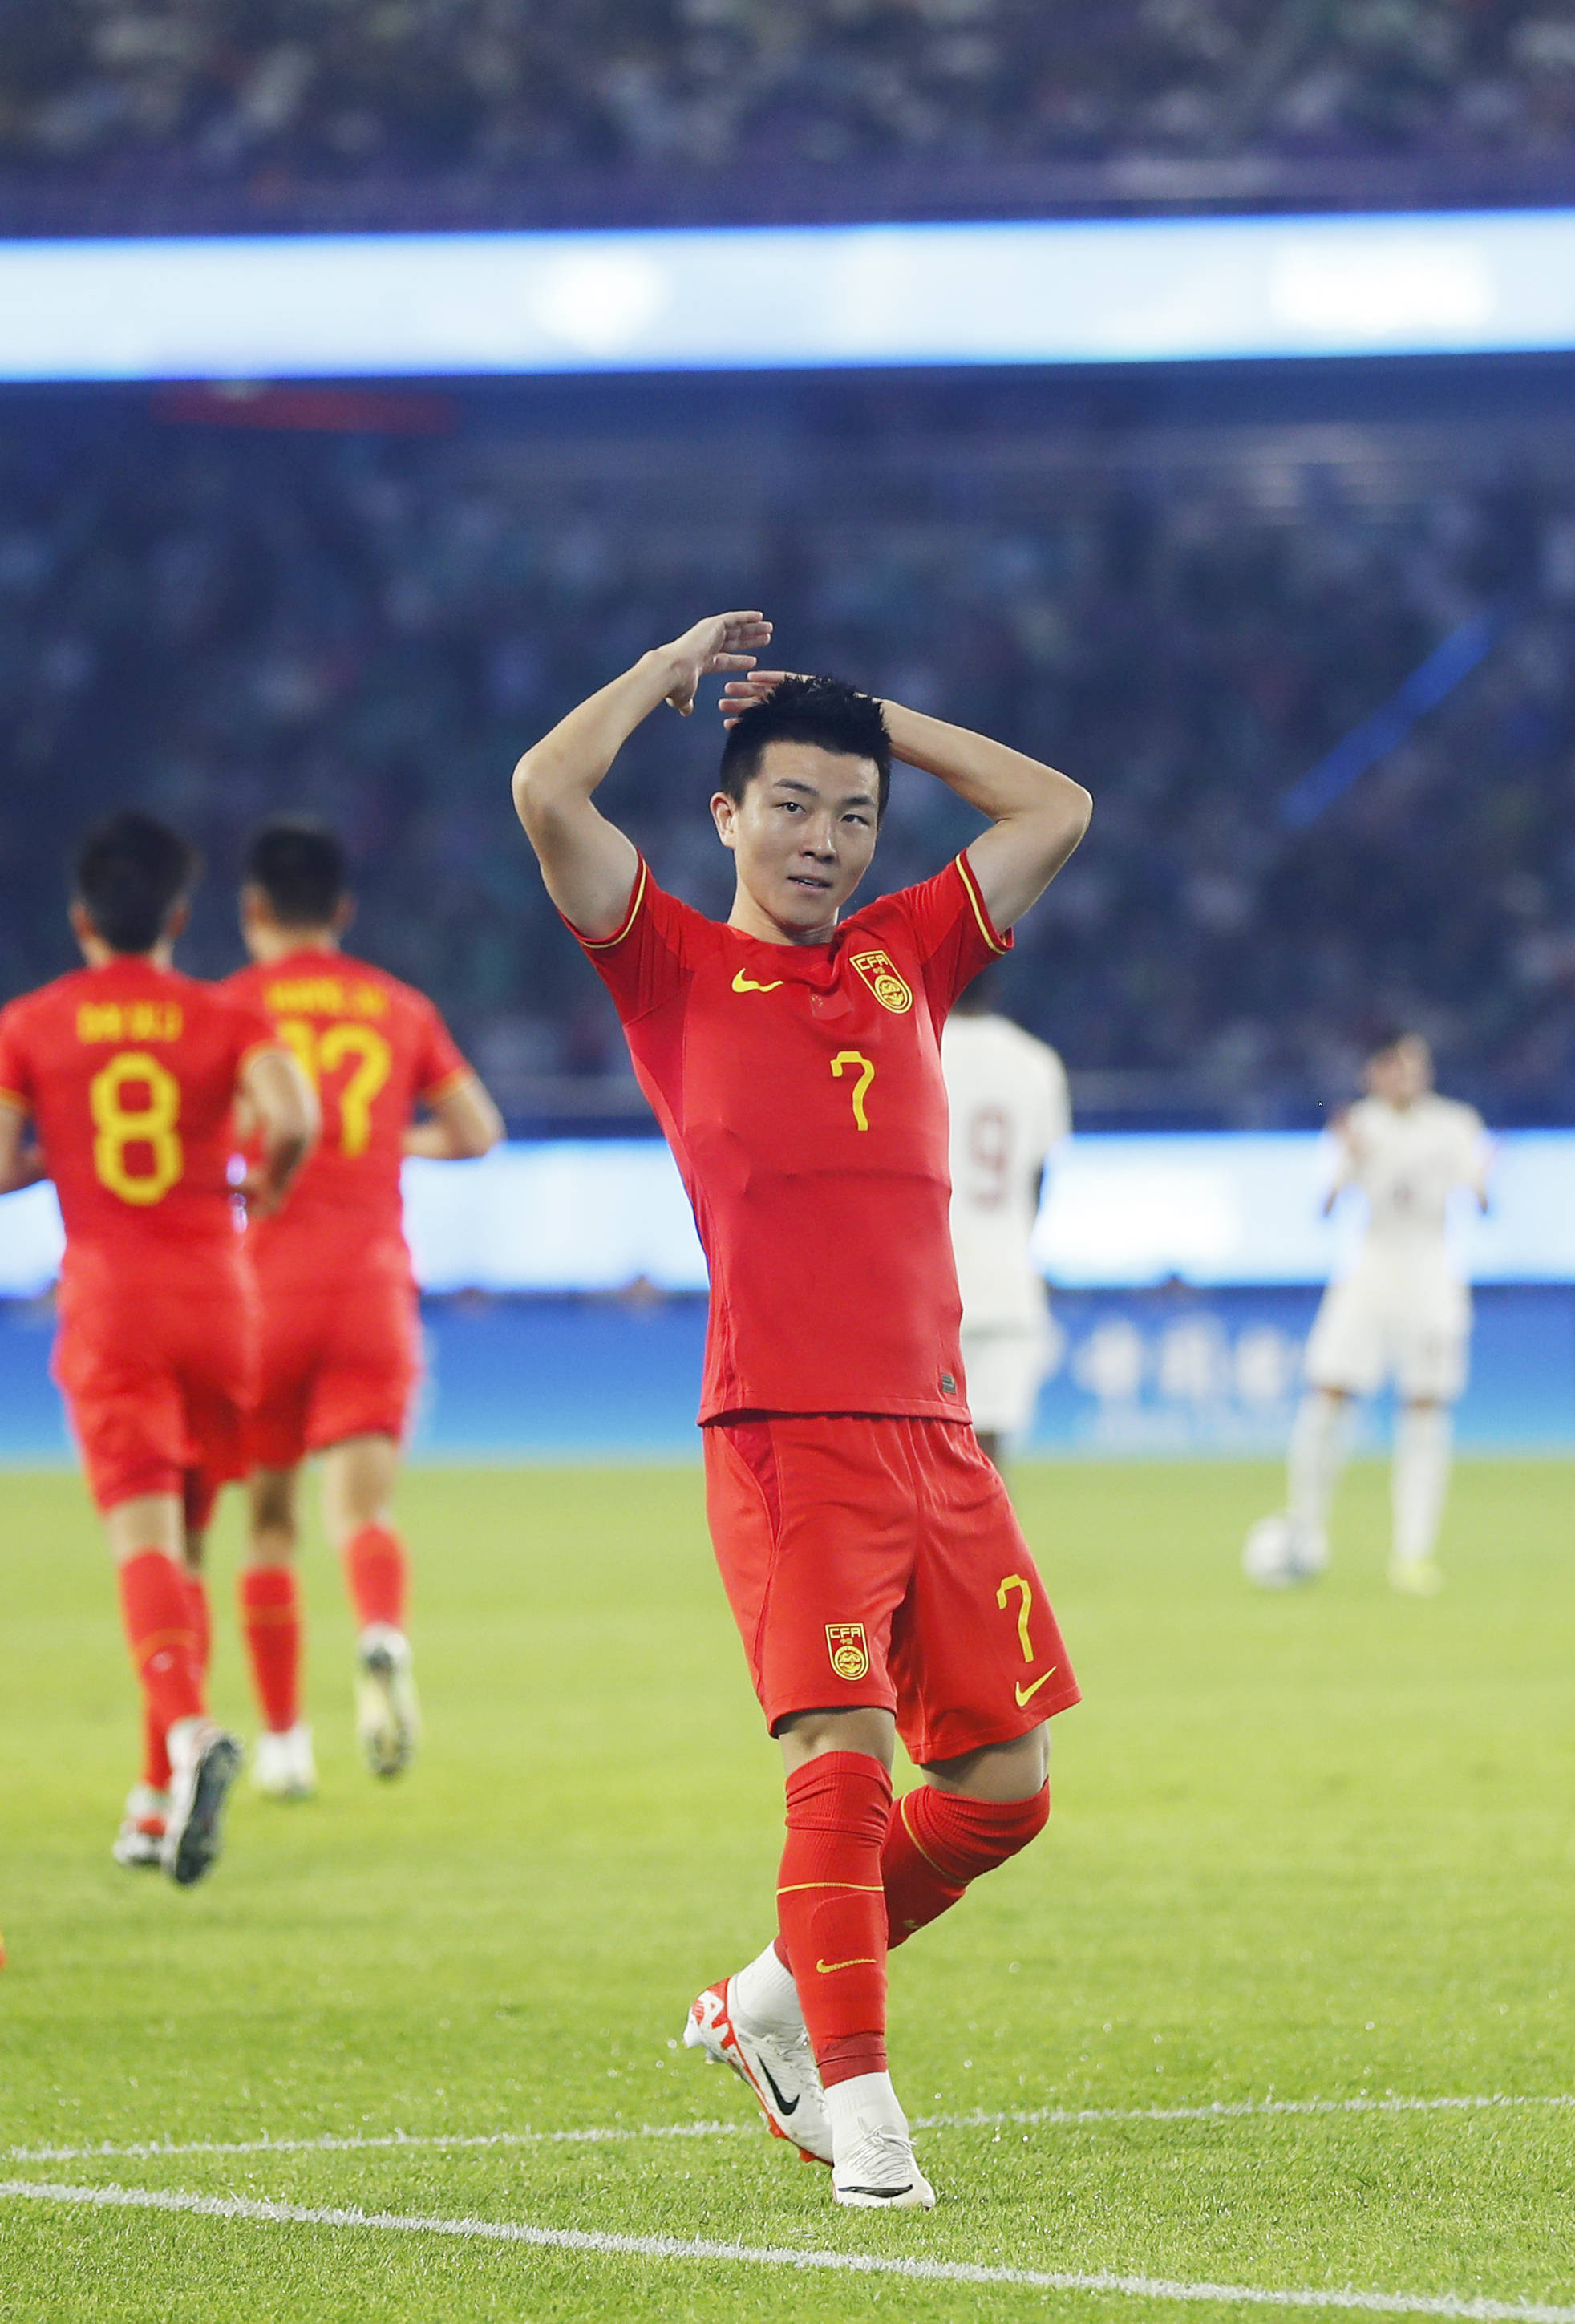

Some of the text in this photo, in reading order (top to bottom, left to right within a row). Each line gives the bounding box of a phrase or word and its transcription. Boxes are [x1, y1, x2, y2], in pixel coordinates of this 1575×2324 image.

[856, 955, 889, 970] CFA
[91, 1051, 183, 1206] 8
[830, 1051, 875, 1132] 7
[969, 1105, 1013, 1209] 9
[829, 1627, 861, 1638] CFA
[996, 1573, 1034, 1663] 7
